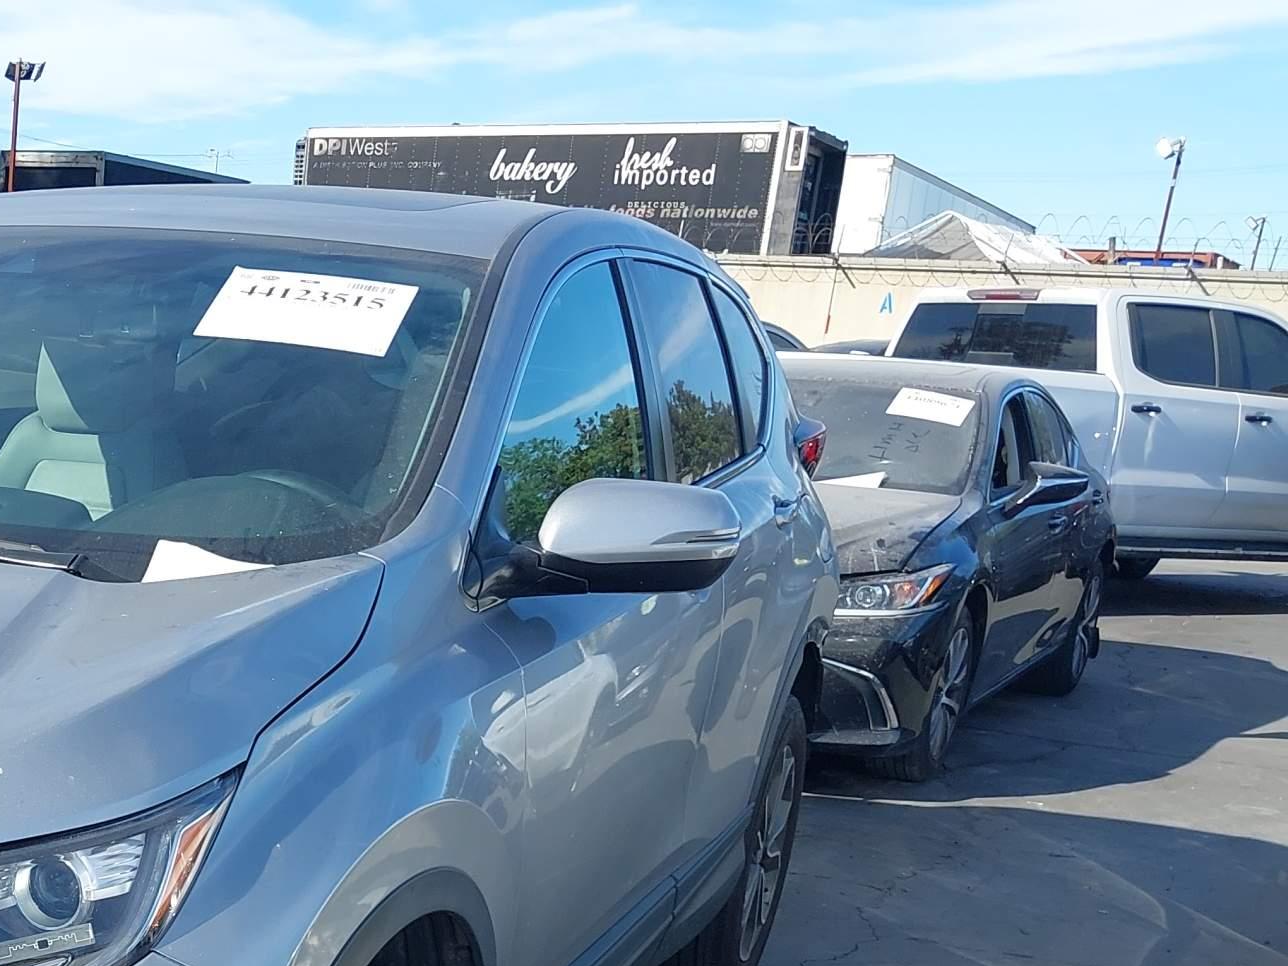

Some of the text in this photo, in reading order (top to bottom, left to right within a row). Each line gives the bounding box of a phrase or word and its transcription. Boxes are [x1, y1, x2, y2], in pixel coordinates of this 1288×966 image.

[620, 136, 678, 173] fresh
[489, 148, 578, 194] bakery
[614, 163, 717, 189] imported
[627, 201, 687, 209] DELICIOUS
[659, 204, 759, 219] nationwide
[240, 284, 387, 310] 44123515
[879, 291, 894, 314] A
